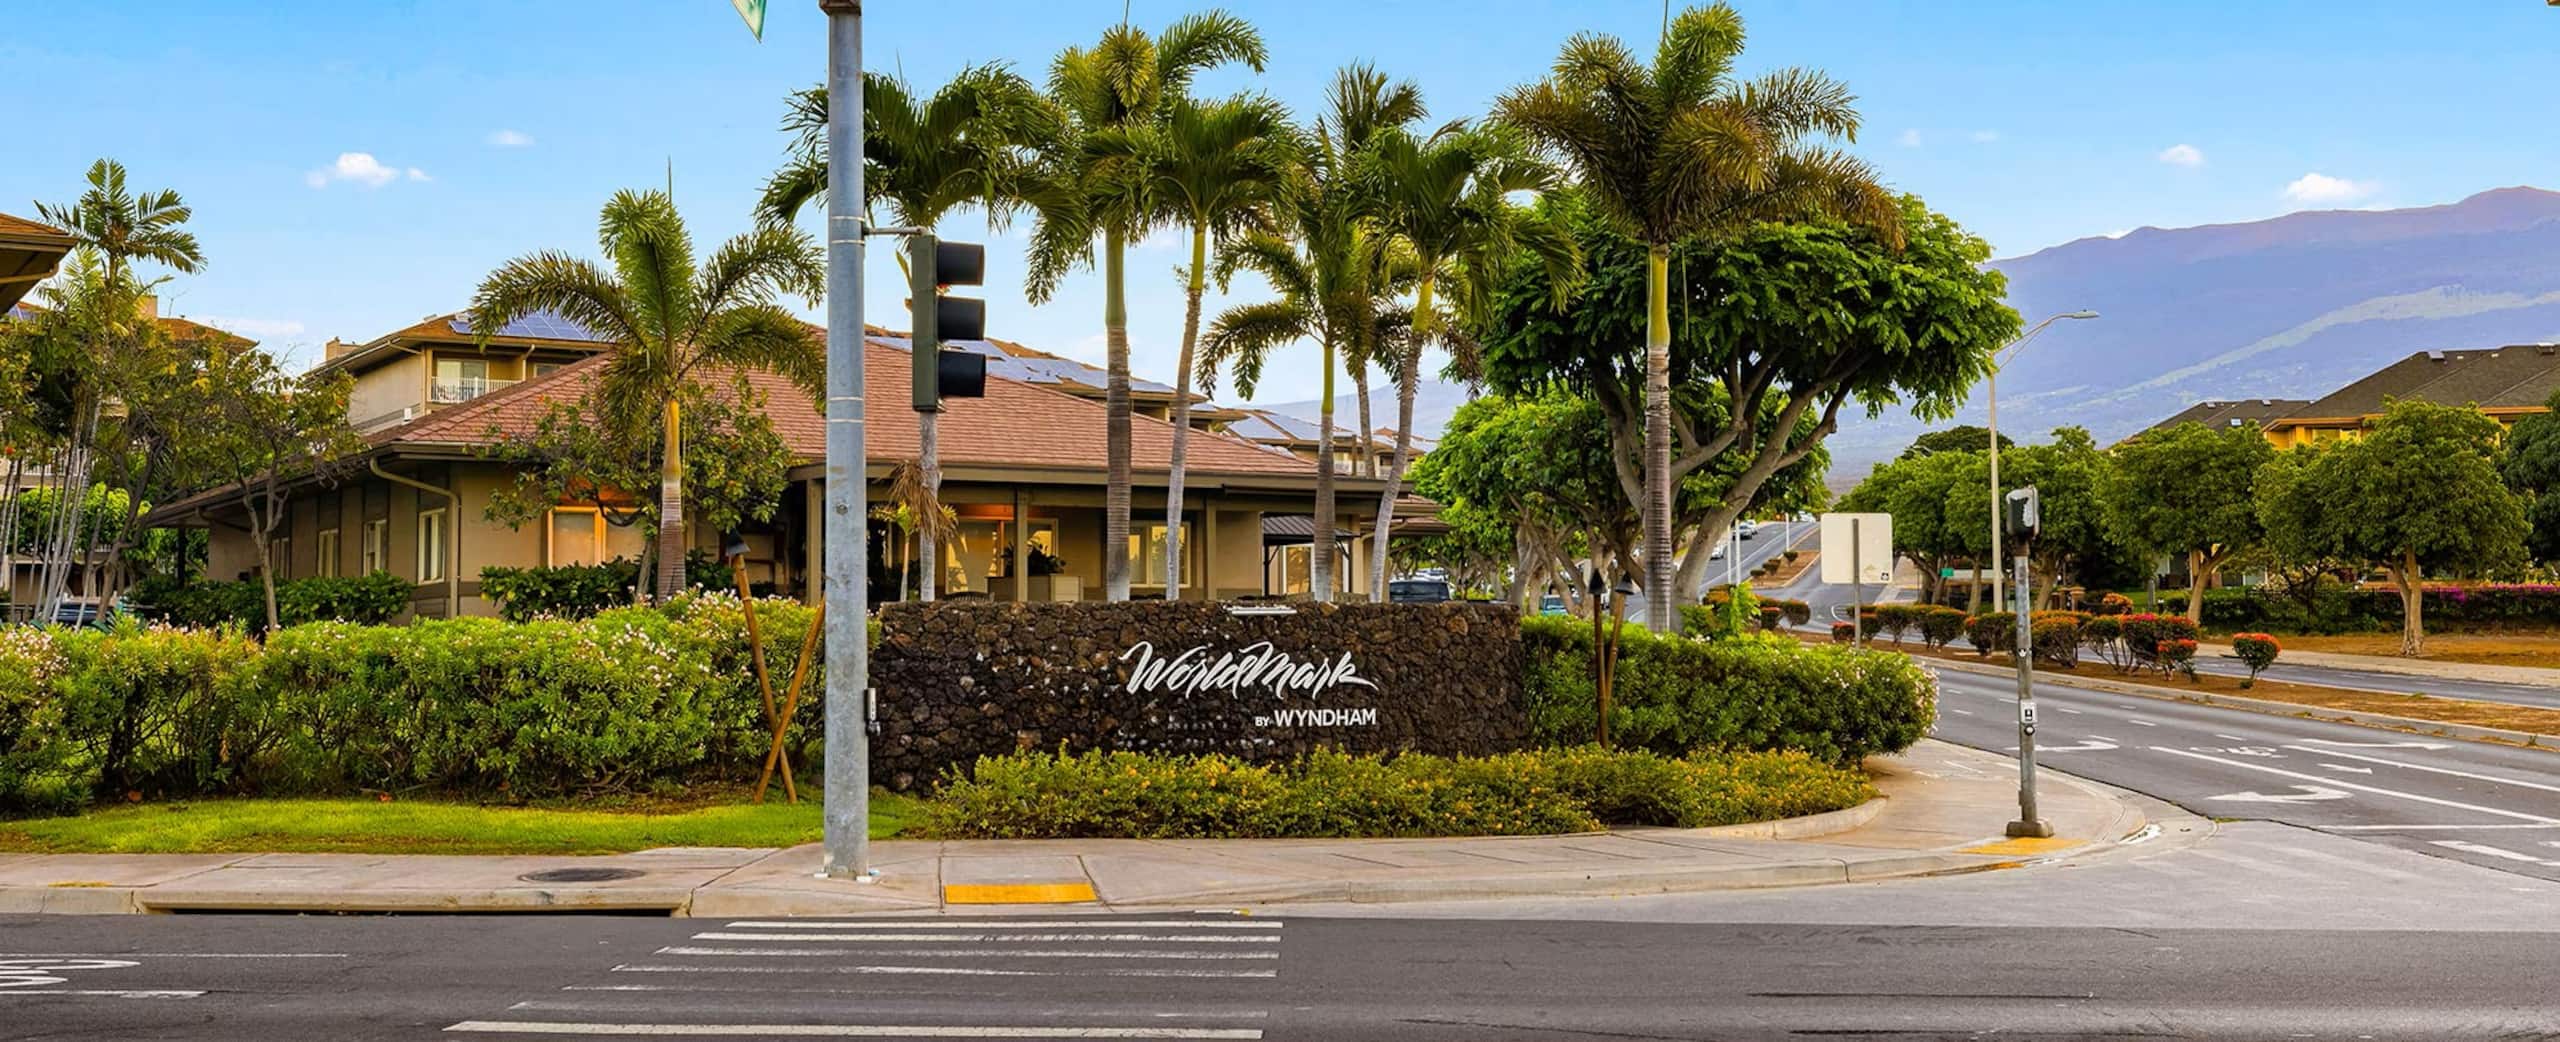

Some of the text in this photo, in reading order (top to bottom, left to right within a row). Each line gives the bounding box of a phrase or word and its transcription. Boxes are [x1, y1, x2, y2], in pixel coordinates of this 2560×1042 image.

[1118, 640, 1379, 700] WorldMark
[1255, 708, 1377, 727] BY WYNDHAM
